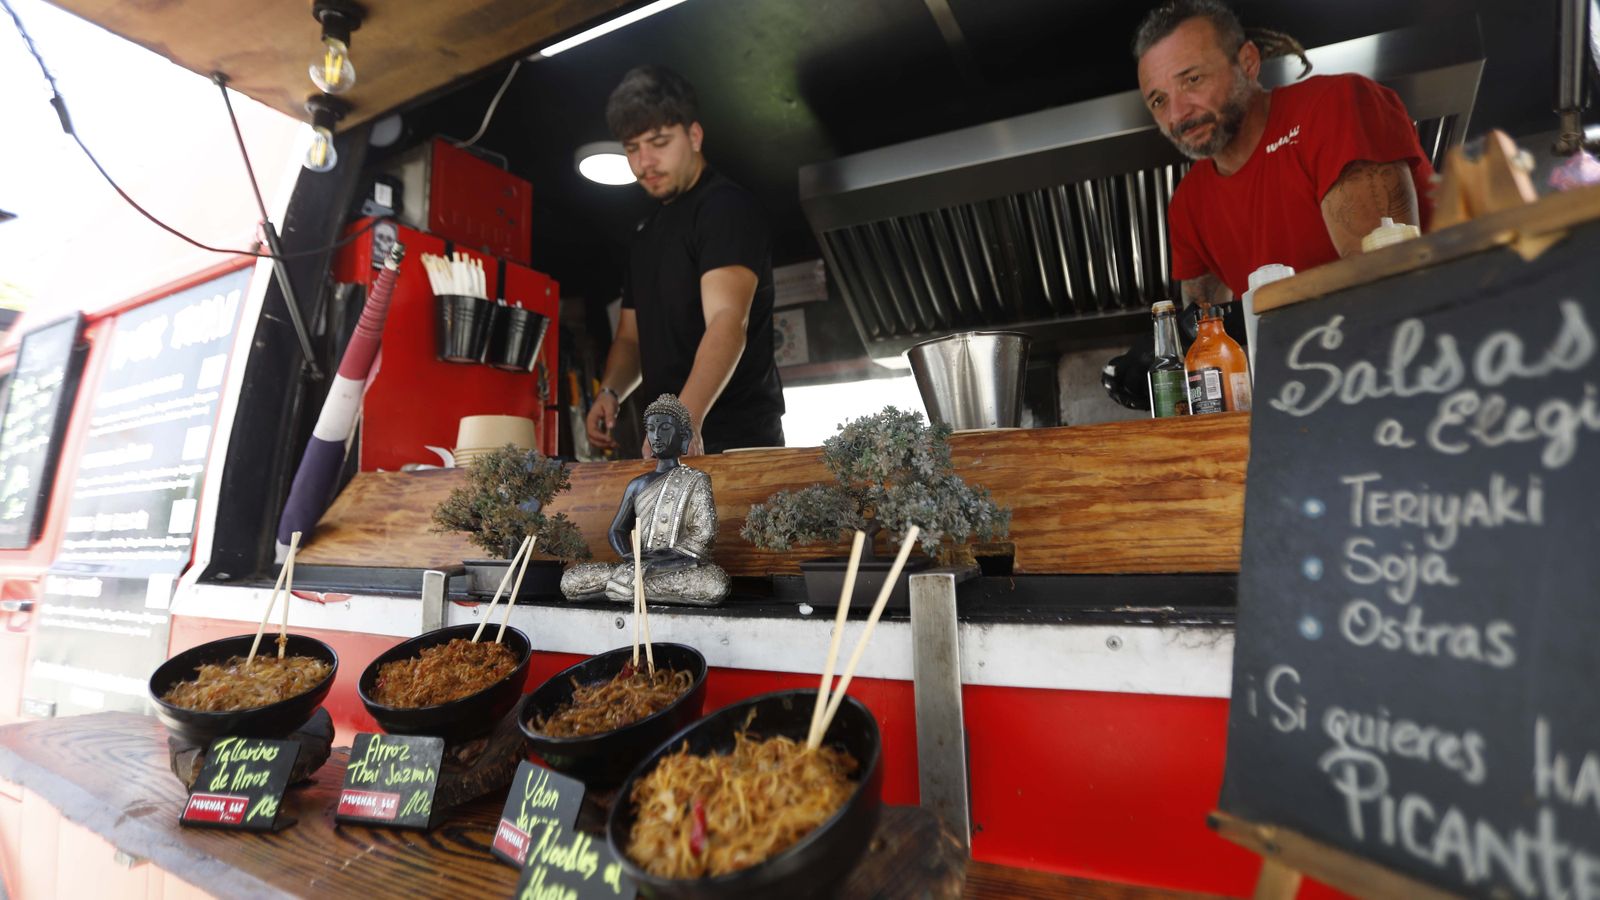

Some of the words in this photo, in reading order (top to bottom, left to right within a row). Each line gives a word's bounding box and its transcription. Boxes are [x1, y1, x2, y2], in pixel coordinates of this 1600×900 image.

[1268, 300, 1597, 417] Salsas
[1374, 418, 1416, 448] a
[1342, 536, 1460, 604] Soja
[1340, 600, 1518, 668] Ostras
[213, 737, 280, 768] Tallarines
[366, 733, 411, 762] Arroz
[209, 764, 230, 792] de
[230, 763, 270, 792] Arroz
[347, 759, 382, 785] Thai
[528, 823, 600, 881] Noodles
